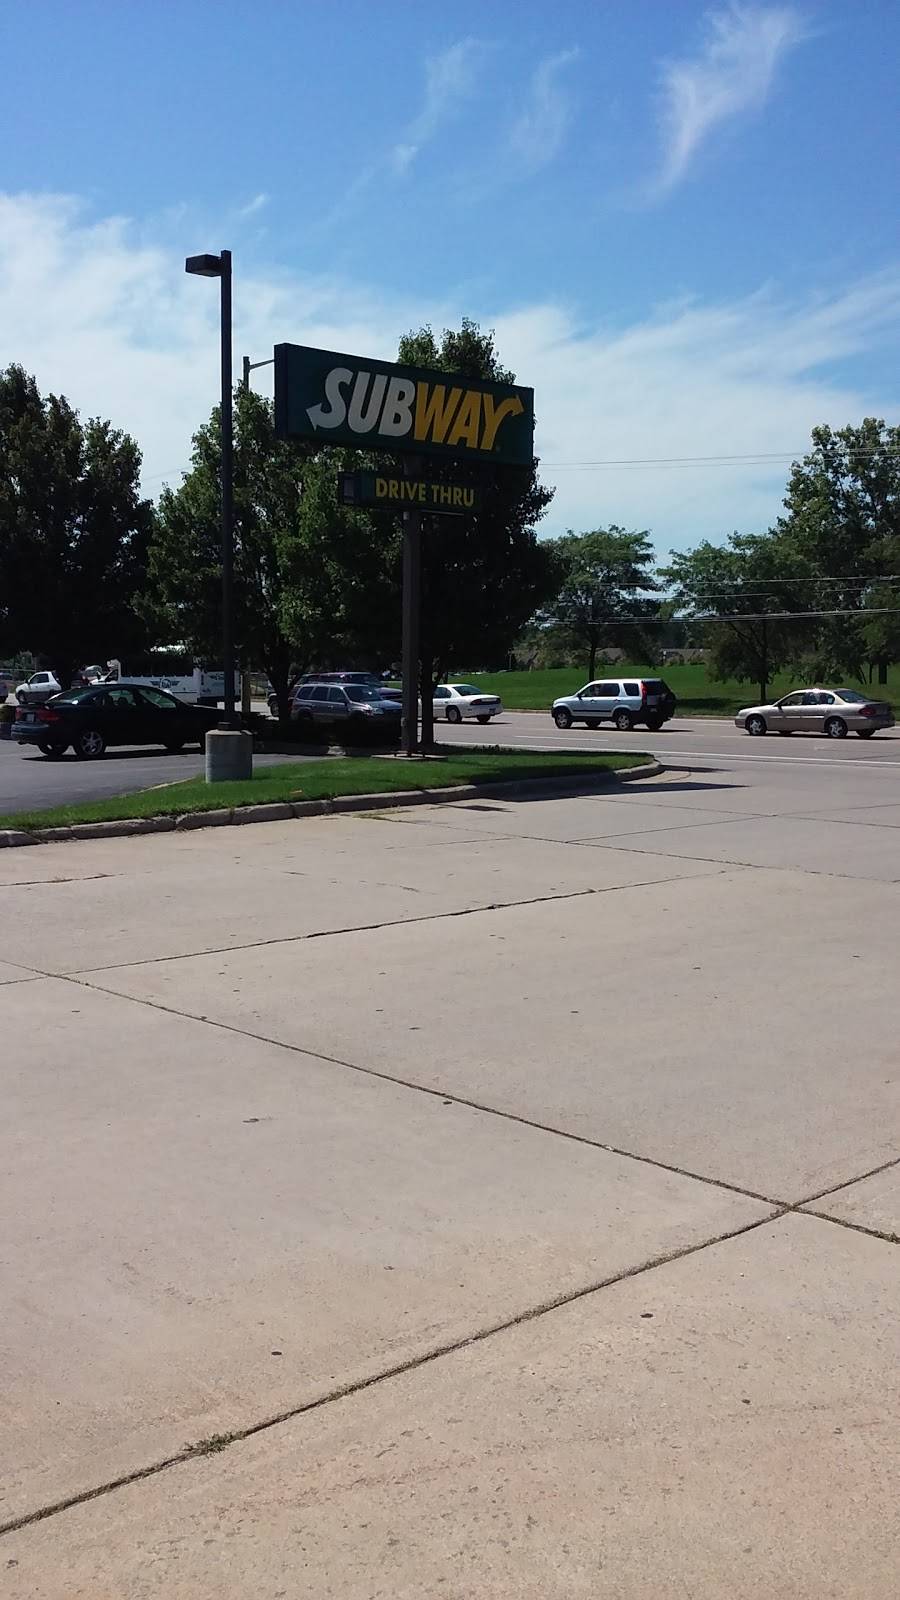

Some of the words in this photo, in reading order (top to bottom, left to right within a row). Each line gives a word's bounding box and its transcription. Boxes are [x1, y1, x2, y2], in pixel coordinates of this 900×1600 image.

[306, 367, 524, 450] SUBWAY
[375, 478, 426, 502] DRIVE
[431, 484, 475, 507] THRU
